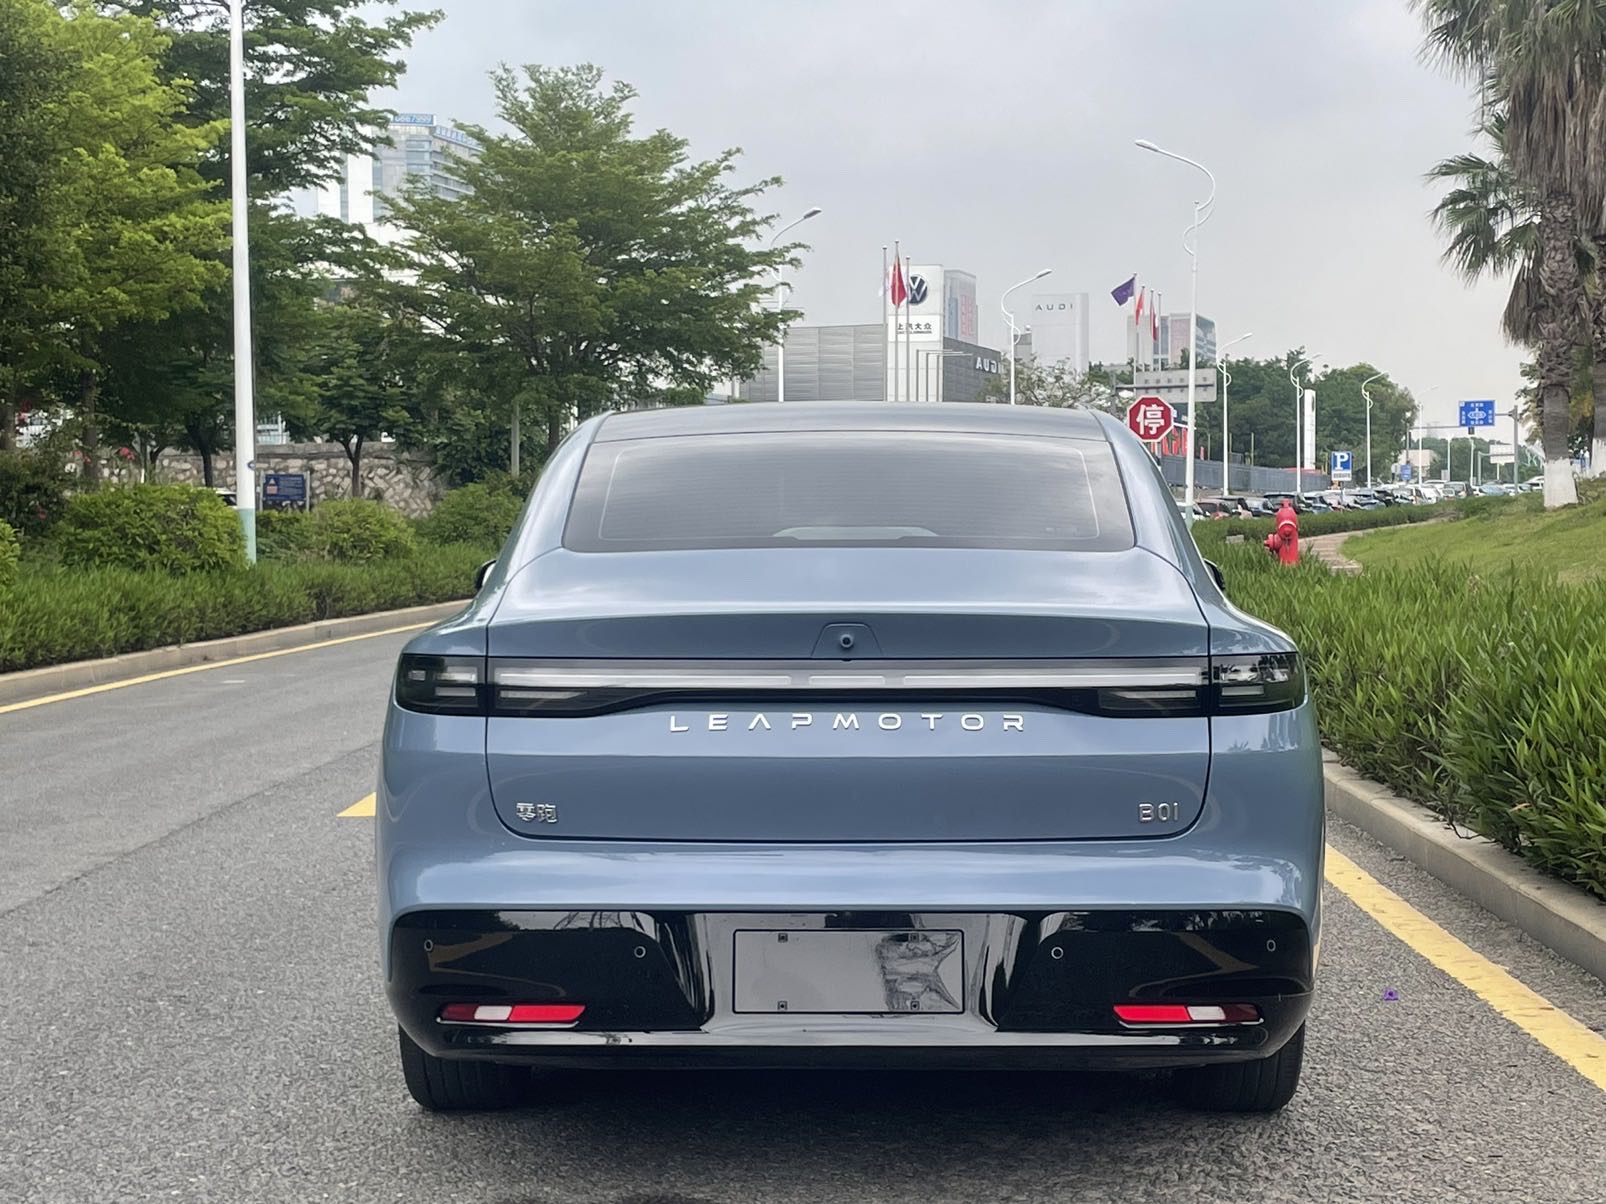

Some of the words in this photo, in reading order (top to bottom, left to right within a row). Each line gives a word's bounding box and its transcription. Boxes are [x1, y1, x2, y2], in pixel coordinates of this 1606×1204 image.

[1035, 303, 1074, 311] AUDI
[1136, 404, 1165, 435] 停
[1334, 452, 1349, 470] P
[669, 713, 1025, 732] LEAPMOTOR
[516, 802, 558, 823] 零跑
